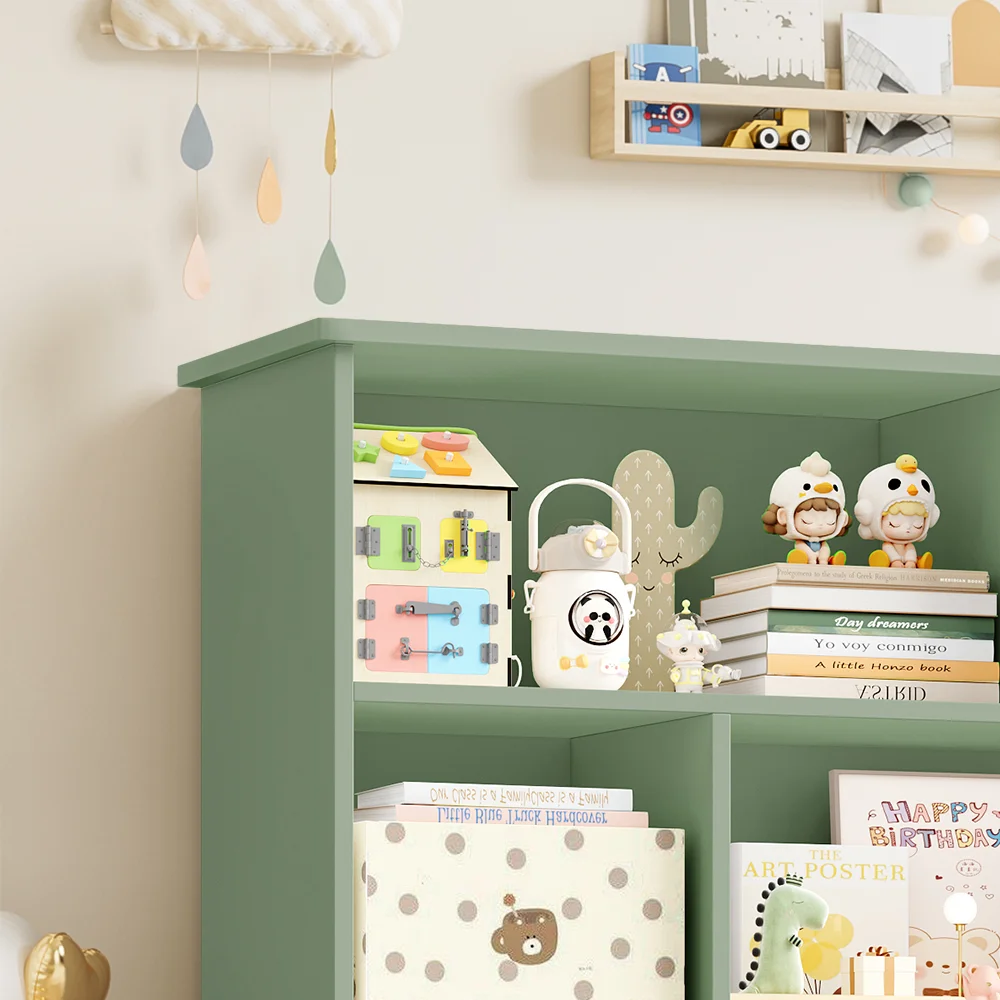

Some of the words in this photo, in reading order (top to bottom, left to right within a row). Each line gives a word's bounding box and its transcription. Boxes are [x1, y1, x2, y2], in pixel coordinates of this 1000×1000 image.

[834, 616, 864, 633] Day
[867, 616, 929, 630] dreamers
[814, 638, 835, 649] Yo
[842, 640, 871, 652] voy
[877, 641, 947, 655] conmigo
[815, 661, 826, 669] A
[832, 661, 865, 670] little
[871, 663, 914, 672] Honzo
[920, 663, 951, 673] book
[881, 800, 988, 823] HAPPY
[809, 849, 842, 861] THE
[743, 861, 795, 878] ART
[804, 862, 906, 881] POSTER
